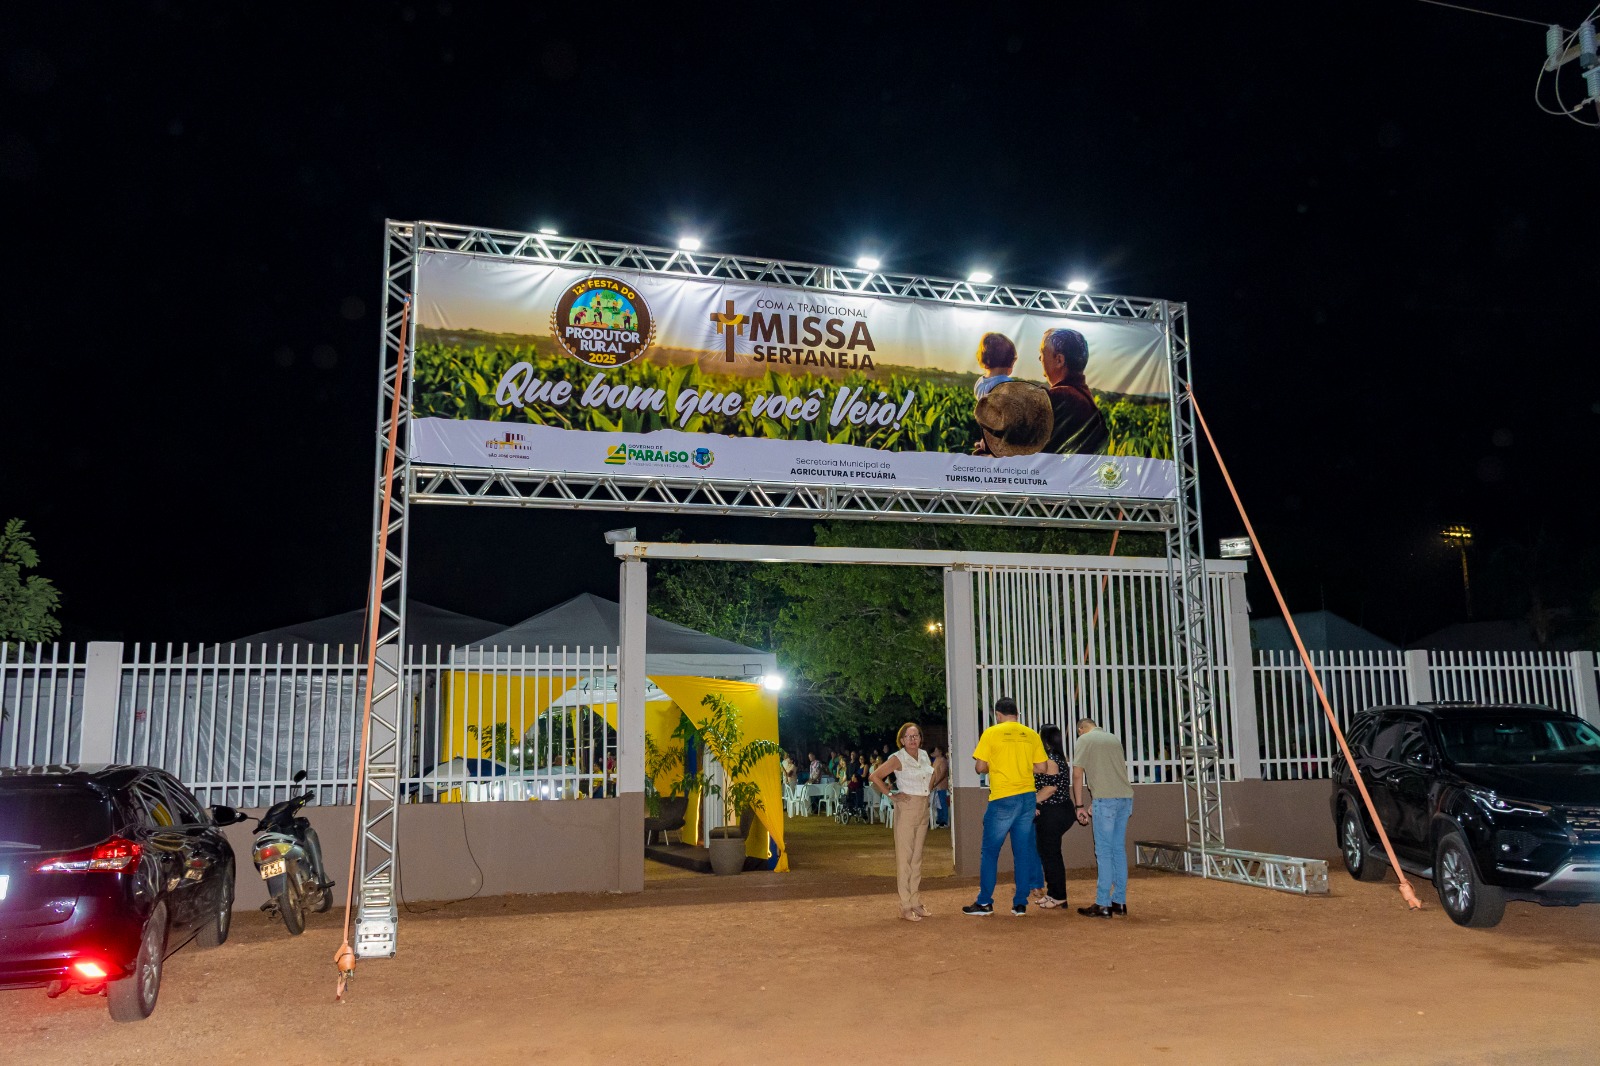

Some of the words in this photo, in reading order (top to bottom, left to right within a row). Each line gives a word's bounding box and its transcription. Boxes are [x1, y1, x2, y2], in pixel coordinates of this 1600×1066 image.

[587, 280, 619, 291] FESTA
[620, 287, 635, 300] DO
[757, 299, 784, 310] COM
[787, 302, 795, 312] A
[797, 303, 868, 318] TRADICIONAL
[565, 326, 640, 344] PRODUTOR
[749, 311, 876, 352] MISSA
[580, 339, 626, 354] RURAL
[588, 352, 617, 364] 2025
[753, 345, 875, 371] SERTANEJA
[495, 361, 573, 409] Que
[580, 372, 667, 412] bom
[675, 388, 743, 429] que
[751, 387, 825, 422] você
[829, 386, 915, 431] Veio!
[796, 457, 838, 467] Secretaria
[839, 459, 879, 470] Municipal
[880, 461, 891, 470] de
[952, 464, 992, 474] Secretaria
[993, 467, 1029, 476] Municipal
[1030, 468, 1040, 476] de
[790, 467, 848, 478] AGRICULTURA
[850, 470, 855, 478] E
[856, 469, 896, 480] PECUÁRIA
[945, 474, 983, 484] TURISMO,
[984, 476, 1007, 484] LAZER
[1013, 477, 1048, 486] CULTURA
